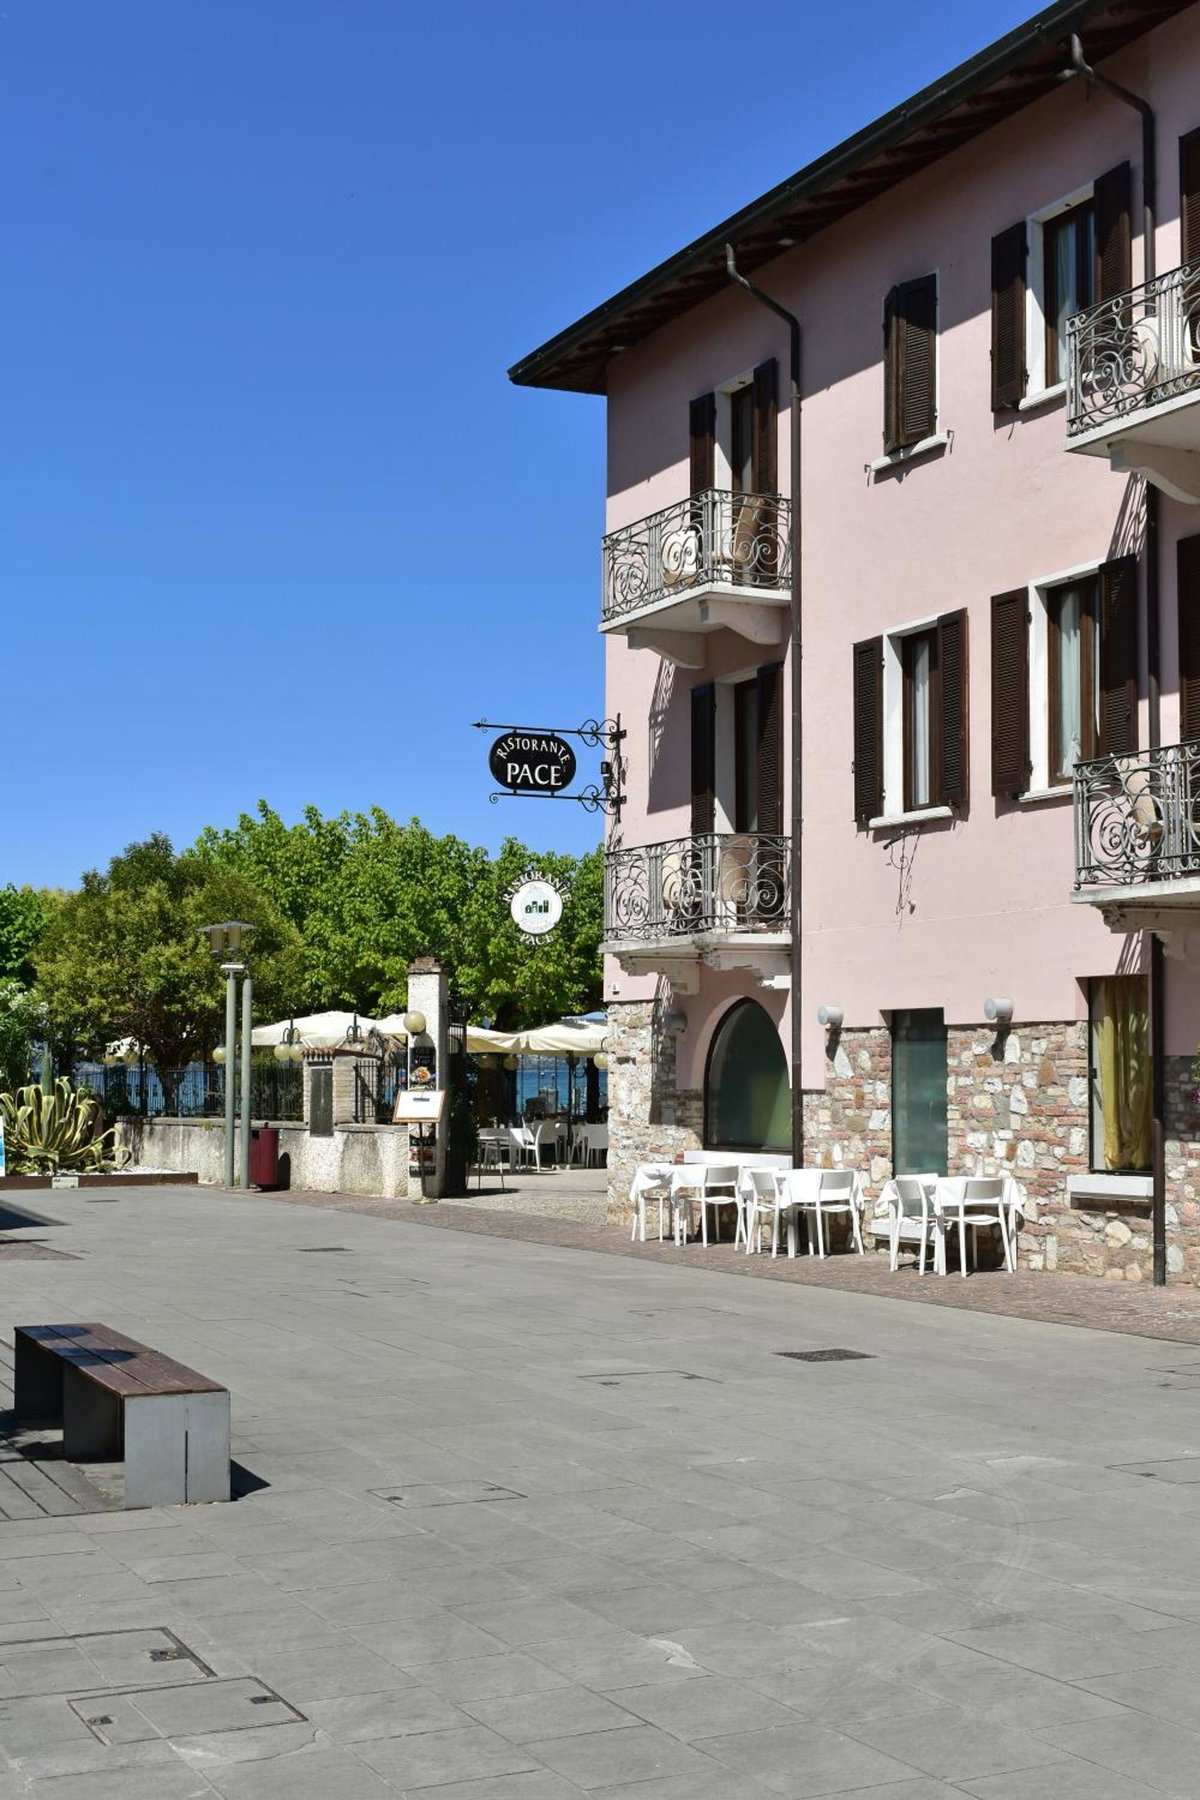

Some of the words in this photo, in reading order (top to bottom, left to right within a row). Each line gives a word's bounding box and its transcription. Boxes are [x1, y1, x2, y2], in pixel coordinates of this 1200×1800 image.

[496, 737, 571, 764] RISTORANTE
[506, 762, 563, 786] PACE
[502, 871, 572, 903] RISTORANTE
[520, 933, 554, 946] PACE
